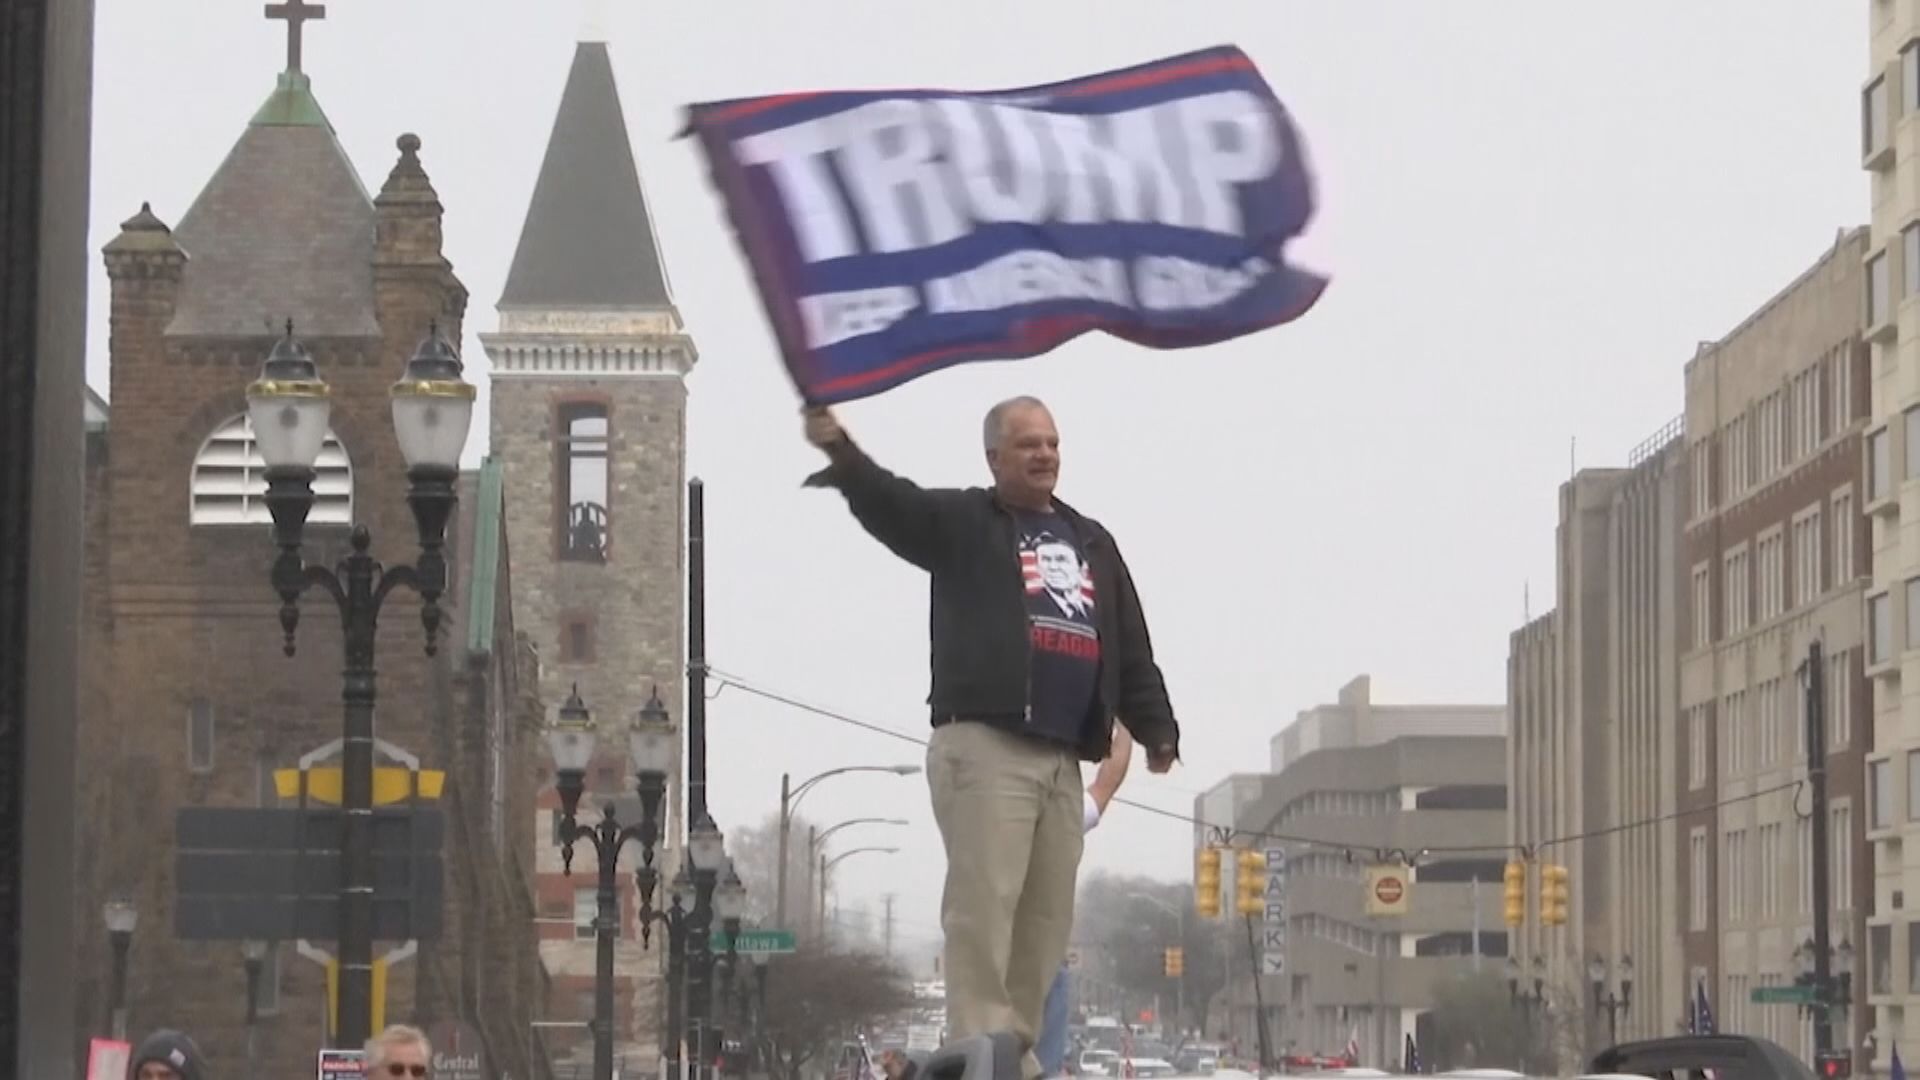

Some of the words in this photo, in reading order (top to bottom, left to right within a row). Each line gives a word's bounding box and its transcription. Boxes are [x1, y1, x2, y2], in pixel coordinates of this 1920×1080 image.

[733, 90, 1281, 261] TRUMP
[1032, 627, 1098, 659] REAG
[1266, 849, 1283, 945] PARK
[733, 936, 779, 950] ttawa
[433, 1051, 479, 1071] Central
